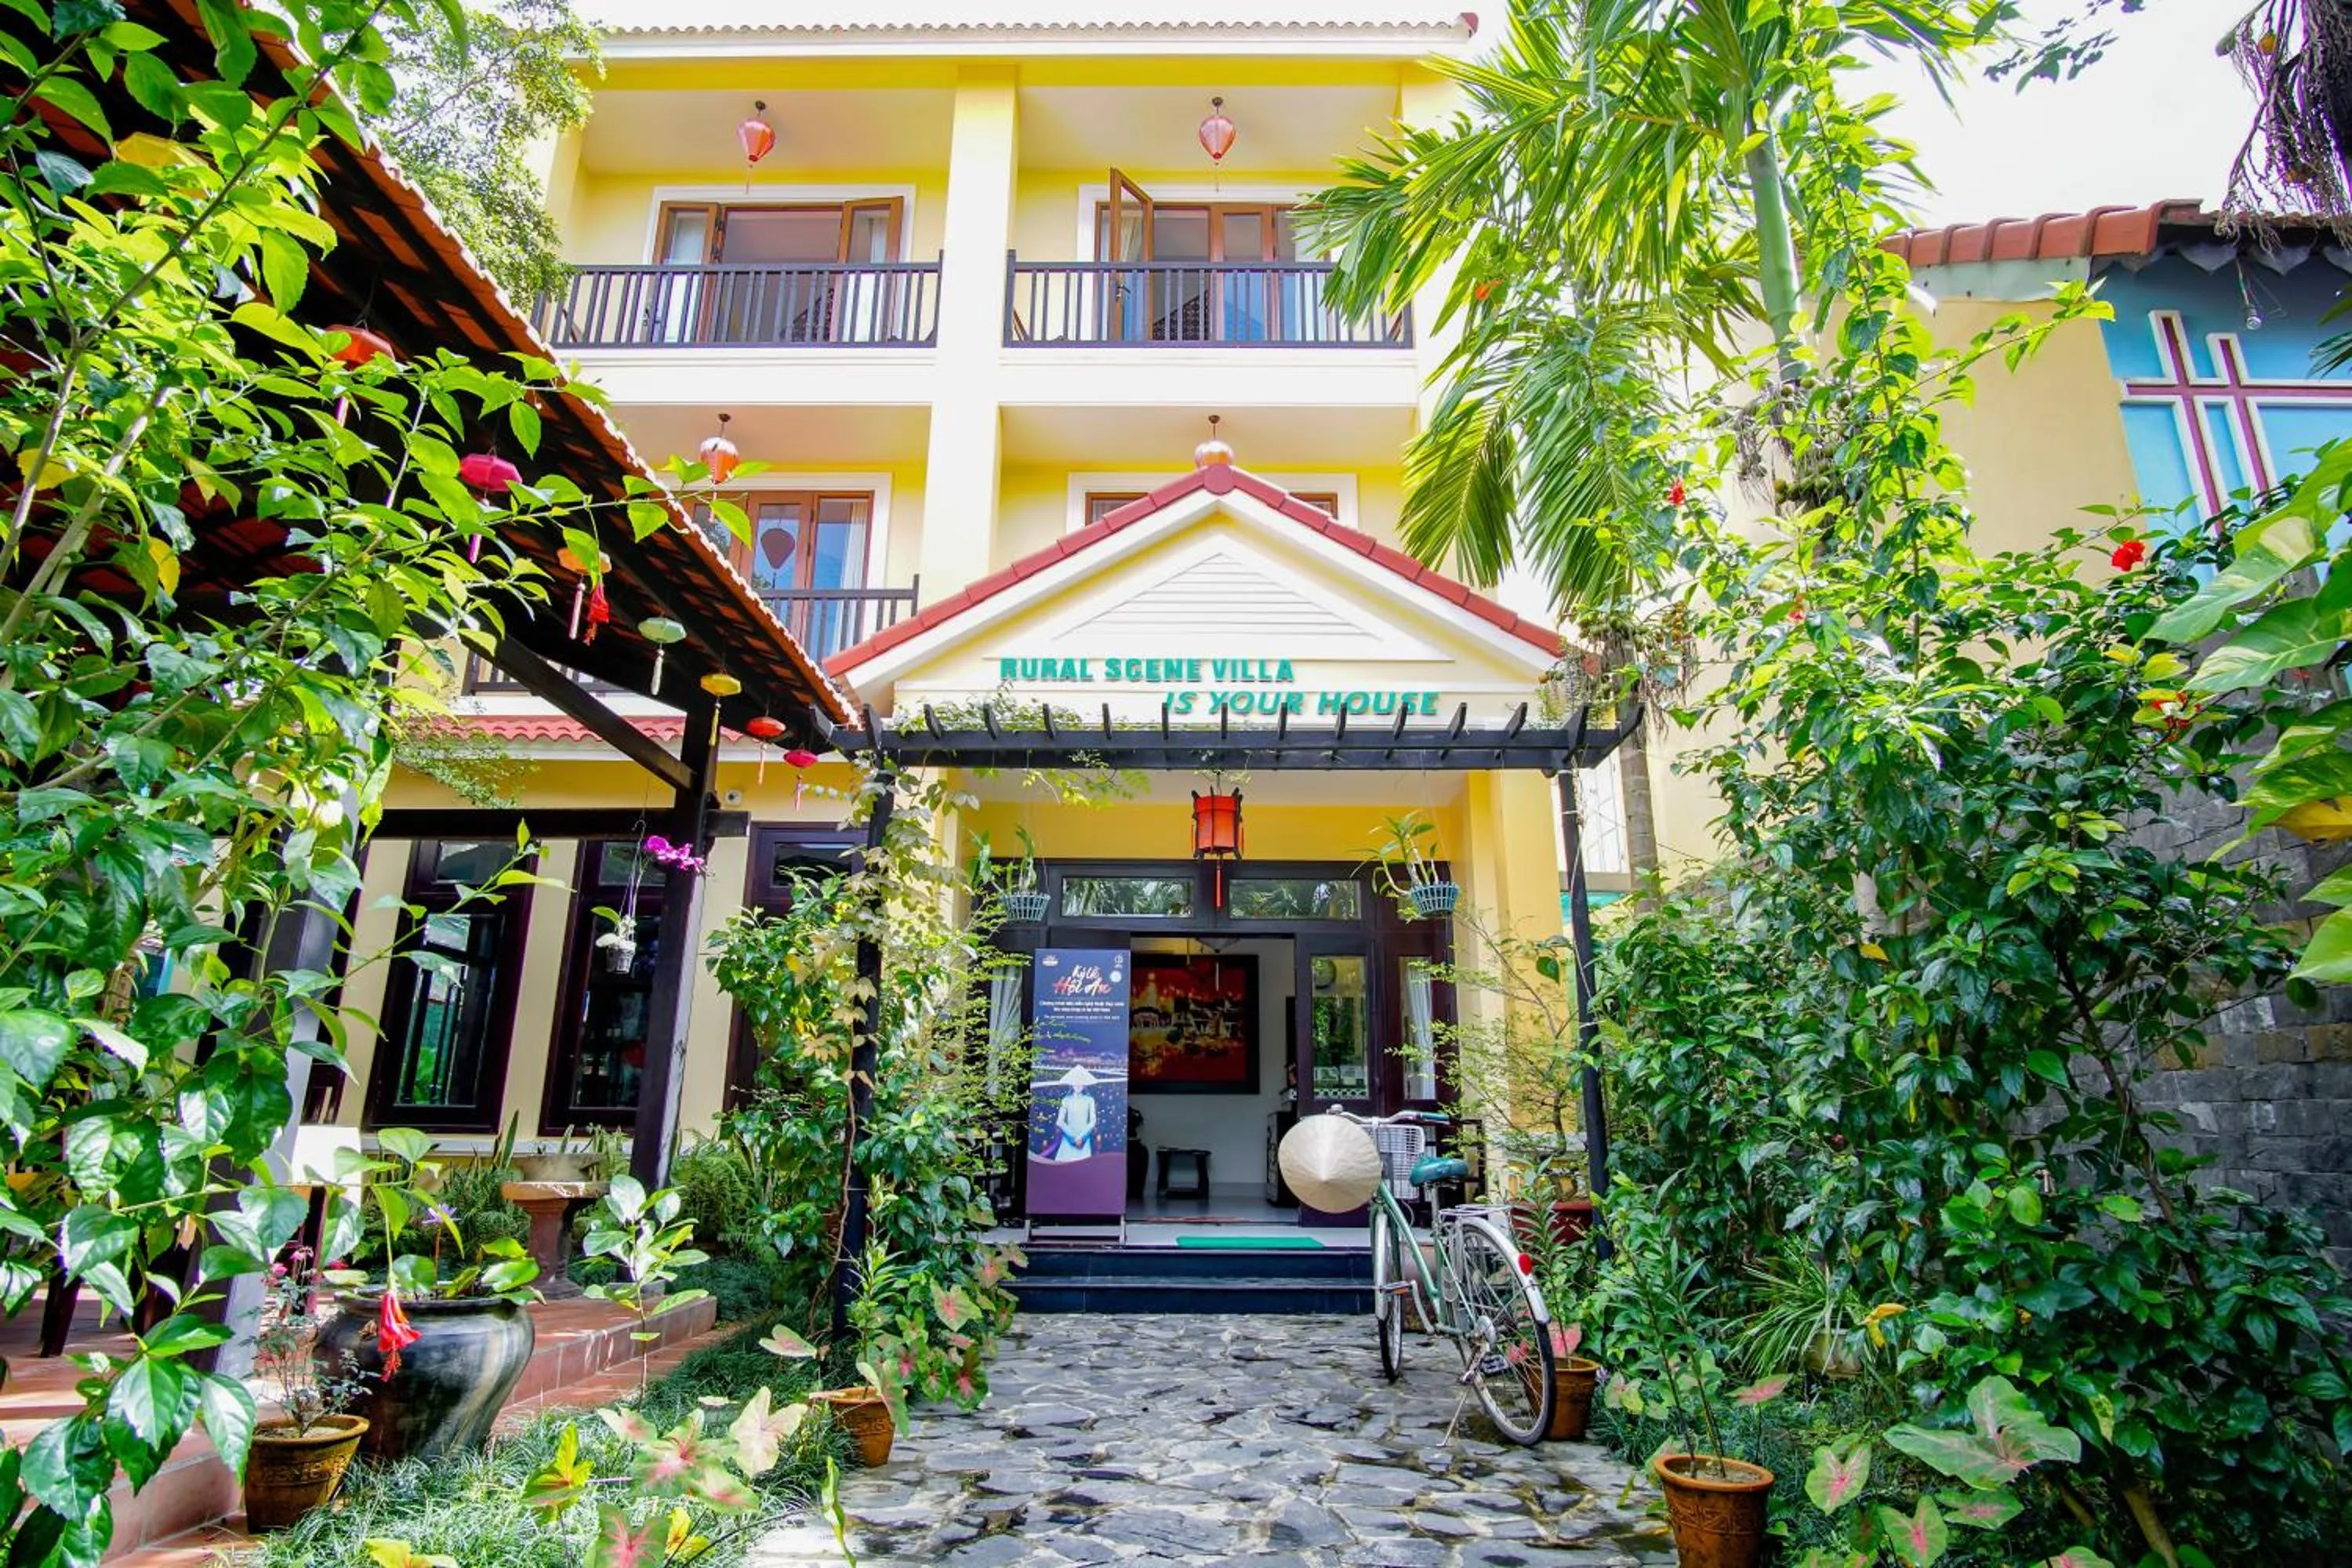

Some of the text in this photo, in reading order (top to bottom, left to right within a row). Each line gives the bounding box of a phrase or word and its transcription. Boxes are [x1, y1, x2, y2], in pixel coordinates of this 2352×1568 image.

[1000, 656, 1295, 682] RURAL SCENE VILLA
[1164, 690, 1440, 714] IS YOUR HOUSE
